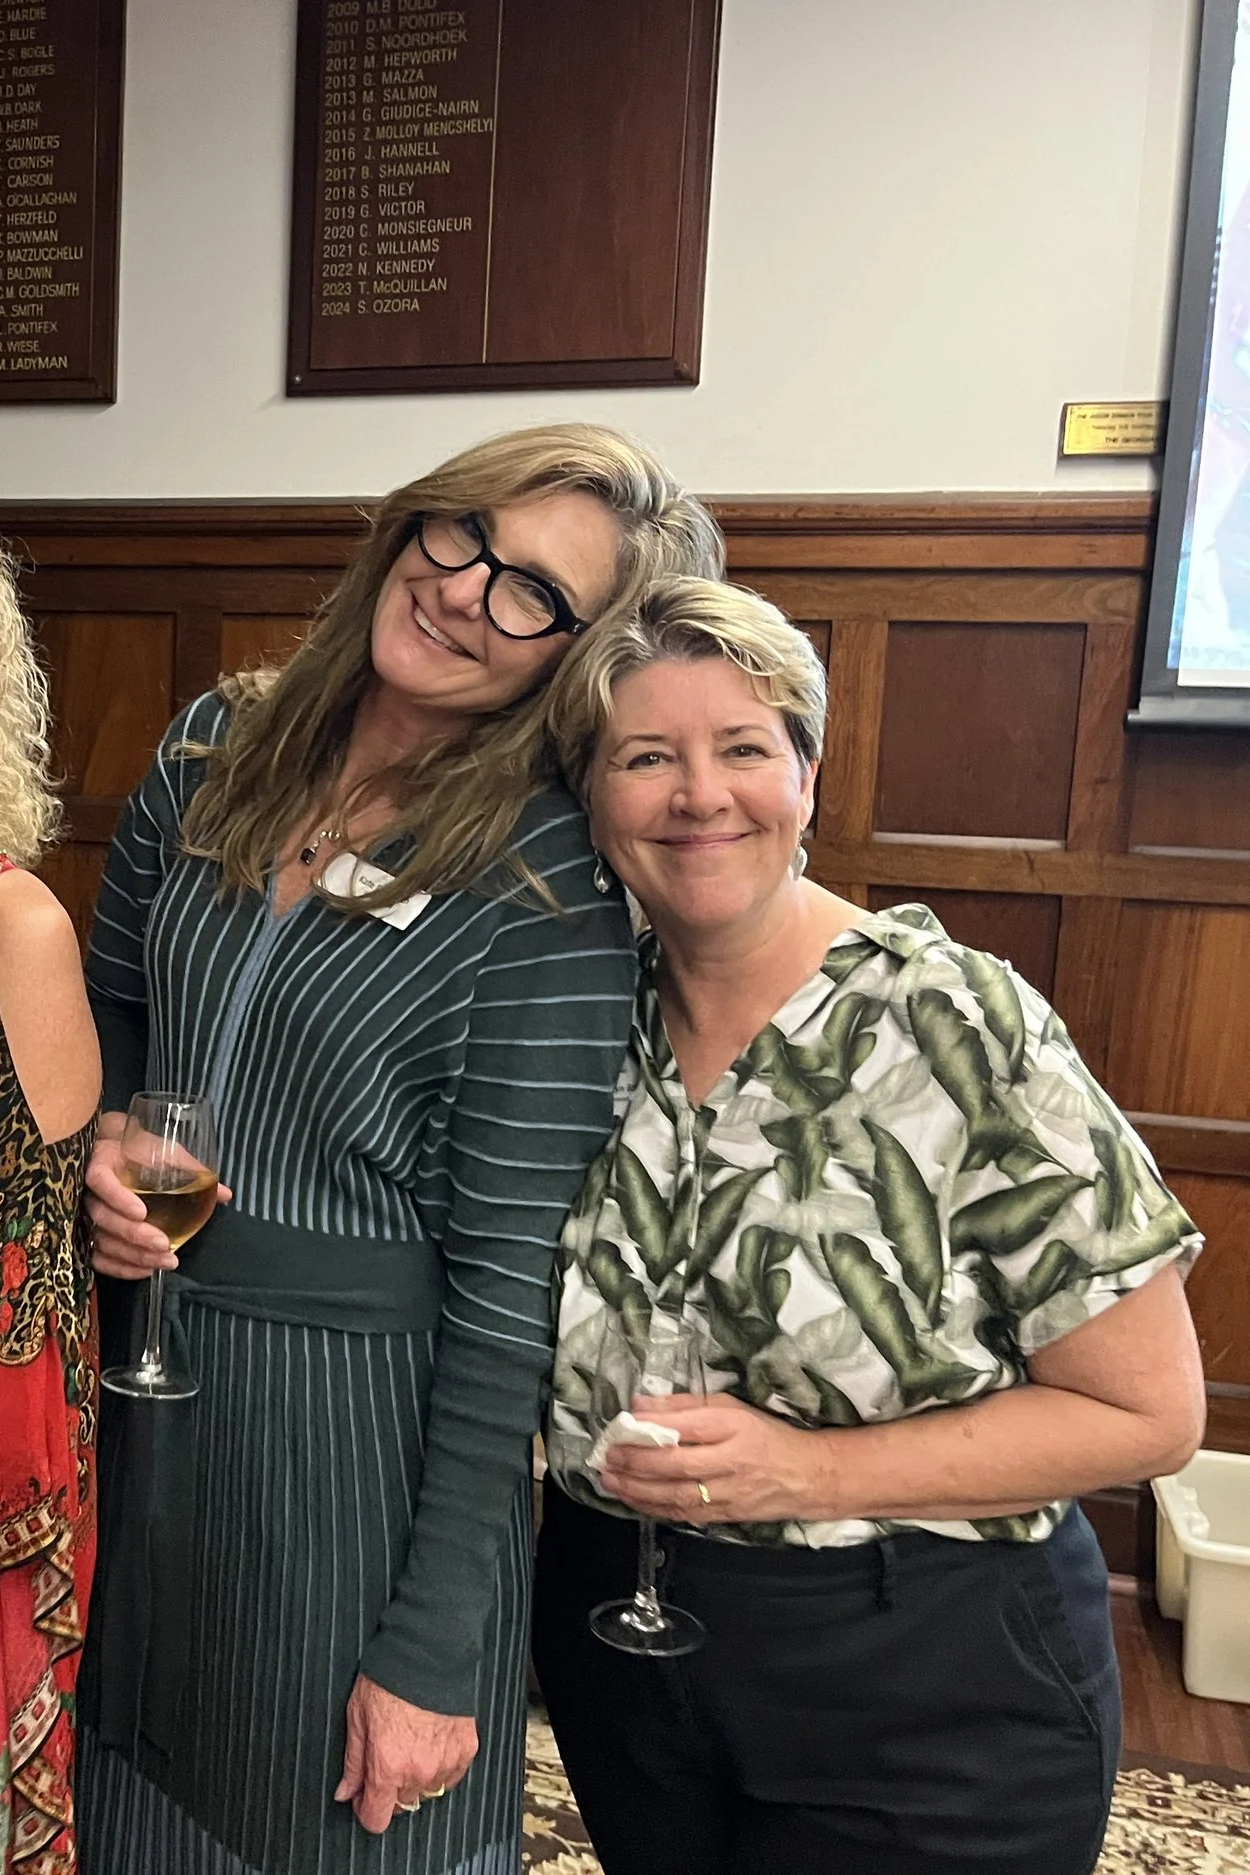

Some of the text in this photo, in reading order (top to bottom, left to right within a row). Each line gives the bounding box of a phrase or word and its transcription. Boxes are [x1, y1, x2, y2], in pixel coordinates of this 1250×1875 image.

[7, 7, 47, 22] HARDIE
[327, 2, 360, 18] 2009
[326, 20, 359, 36] 2010
[399, 11, 466, 30] PONTIFEX
[10, 27, 36, 41] BLUE
[326, 39, 355, 54] 2011
[381, 28, 468, 48] NOORDHOEK
[21, 45, 55, 59] BOGLE
[326, 56, 357, 72] 2012
[384, 47, 458, 67] HEPWORTH
[12, 64, 55, 77] ROGERS
[325, 74, 356, 90] 2013
[382, 68, 424, 85] MAZZA
[17, 83, 37, 96] DAY
[325, 91, 356, 107] 2013
[383, 85, 437, 102] SALMON
[15, 101, 42, 114] DARK
[325, 109, 356, 125] 2014
[381, 100, 479, 121] GIUDICE-NAIRN
[7, 118, 38, 132] HEATH
[325, 127, 356, 144] 2015
[376, 123, 420, 140] MOLLOY
[423, 118, 493, 137] MENCSHELYI
[5, 135, 60, 152] SAUNDERS
[325, 147, 356, 163] 2016
[381, 142, 440, 158] HANNELL
[8, 155, 54, 169] CORNISH
[325, 167, 356, 182] 2017
[379, 160, 450, 178] SHANAHAN
[7, 173, 53, 188] CARSON
[325, 186, 355, 201] 2018
[378, 182, 414, 197] RILEY
[7, 210, 57, 225] HERZFELD
[324, 205, 355, 221] 2019
[379, 200, 425, 217] VICTOR
[324, 225, 354, 240] 2020
[378, 216, 472, 236] MONSIEGNEUR
[6, 229, 58, 244] BOWMAN
[7, 246, 83, 262] MAZZUCCHELLI
[323, 243, 352, 258] 2021
[377, 238, 440, 255] WILLIAMS
[7, 266, 52, 280] BALDWIN
[322, 262, 353, 278] 2022
[376, 258, 435, 275] KENNEDY
[19, 282, 80, 298] GOLDSMITH
[322, 277, 448, 296] 2023 T. McQUILLAN
[11, 303, 43, 317] SMITH
[322, 301, 350, 316] 2024
[373, 298, 420, 313] OZORA
[8, 320, 58, 334] PONTIFEX
[7, 340, 39, 352] WIESE
[11, 355, 68, 370] LADYMAN
